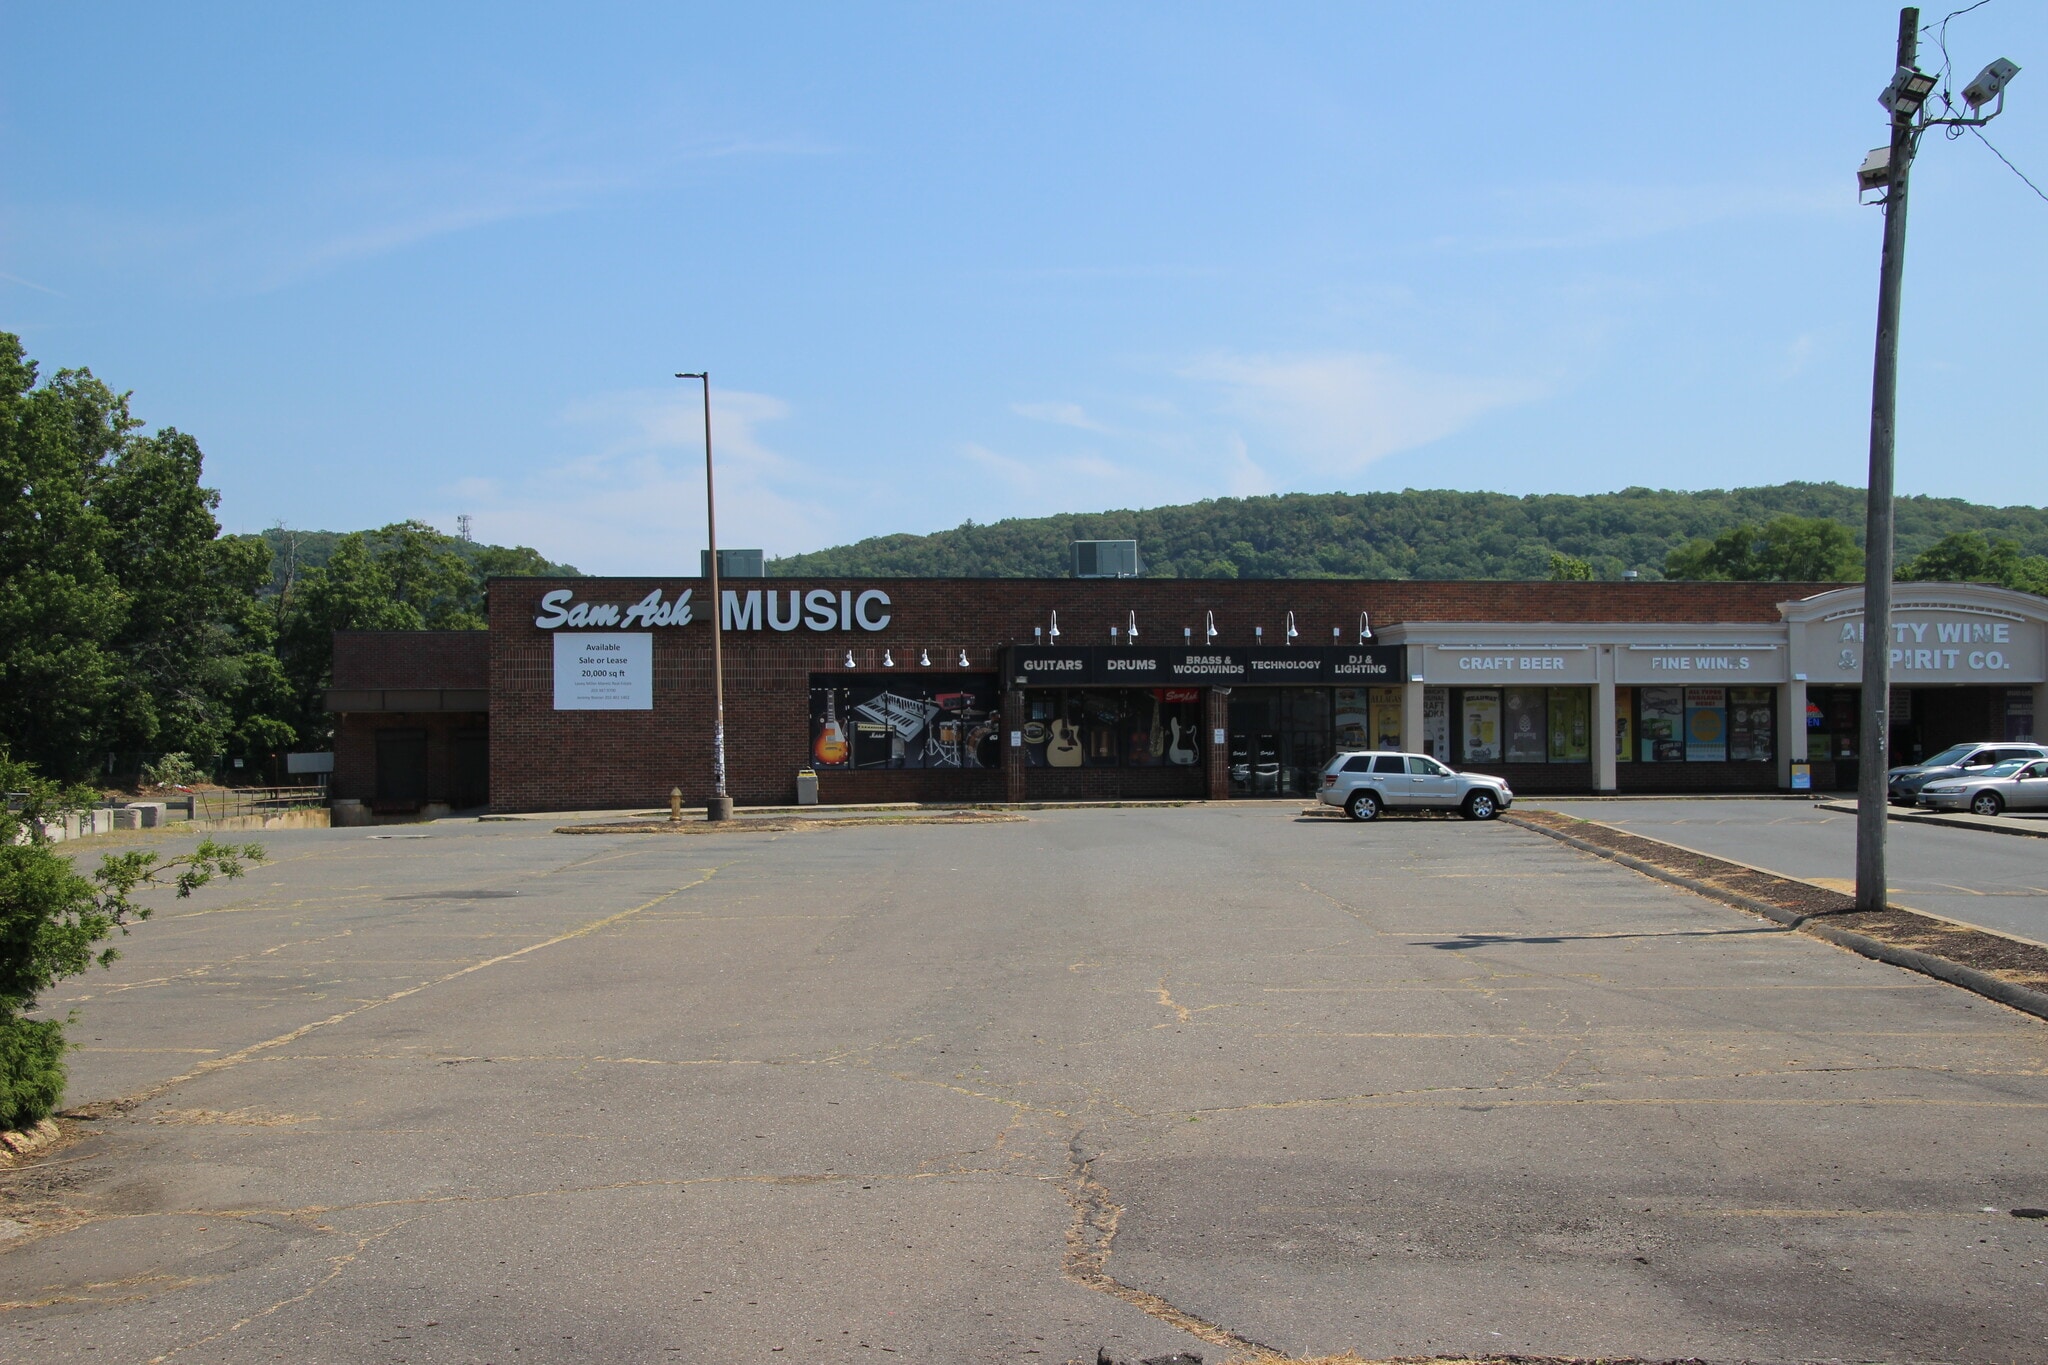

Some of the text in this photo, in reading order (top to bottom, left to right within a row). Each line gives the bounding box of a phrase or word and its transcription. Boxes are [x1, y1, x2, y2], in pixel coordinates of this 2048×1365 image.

[535, 588, 693, 629] Sam Ash
[721, 589, 892, 632] MUSIC
[1839, 623, 2010, 643] ATY WINE
[1186, 656, 1232, 665] BRASS &
[1349, 655, 1373, 664] DJ &
[1459, 657, 1565, 670] CRAFT BEER
[1652, 657, 1750, 670] FINE WINS
[1890, 649, 1960, 669] PIRIT
[1968, 651, 2010, 669] CO.
[1024, 660, 1083, 671] GUITARS
[1107, 660, 1157, 670] DRUMS
[1173, 665, 1245, 674] WOODWINDS
[1251, 661, 1321, 670] TECHNOLOGY
[1334, 665, 1387, 674] LIGHTING
[581, 670, 608, 678] 20,000
[1423, 701, 1445, 710] RAFT
